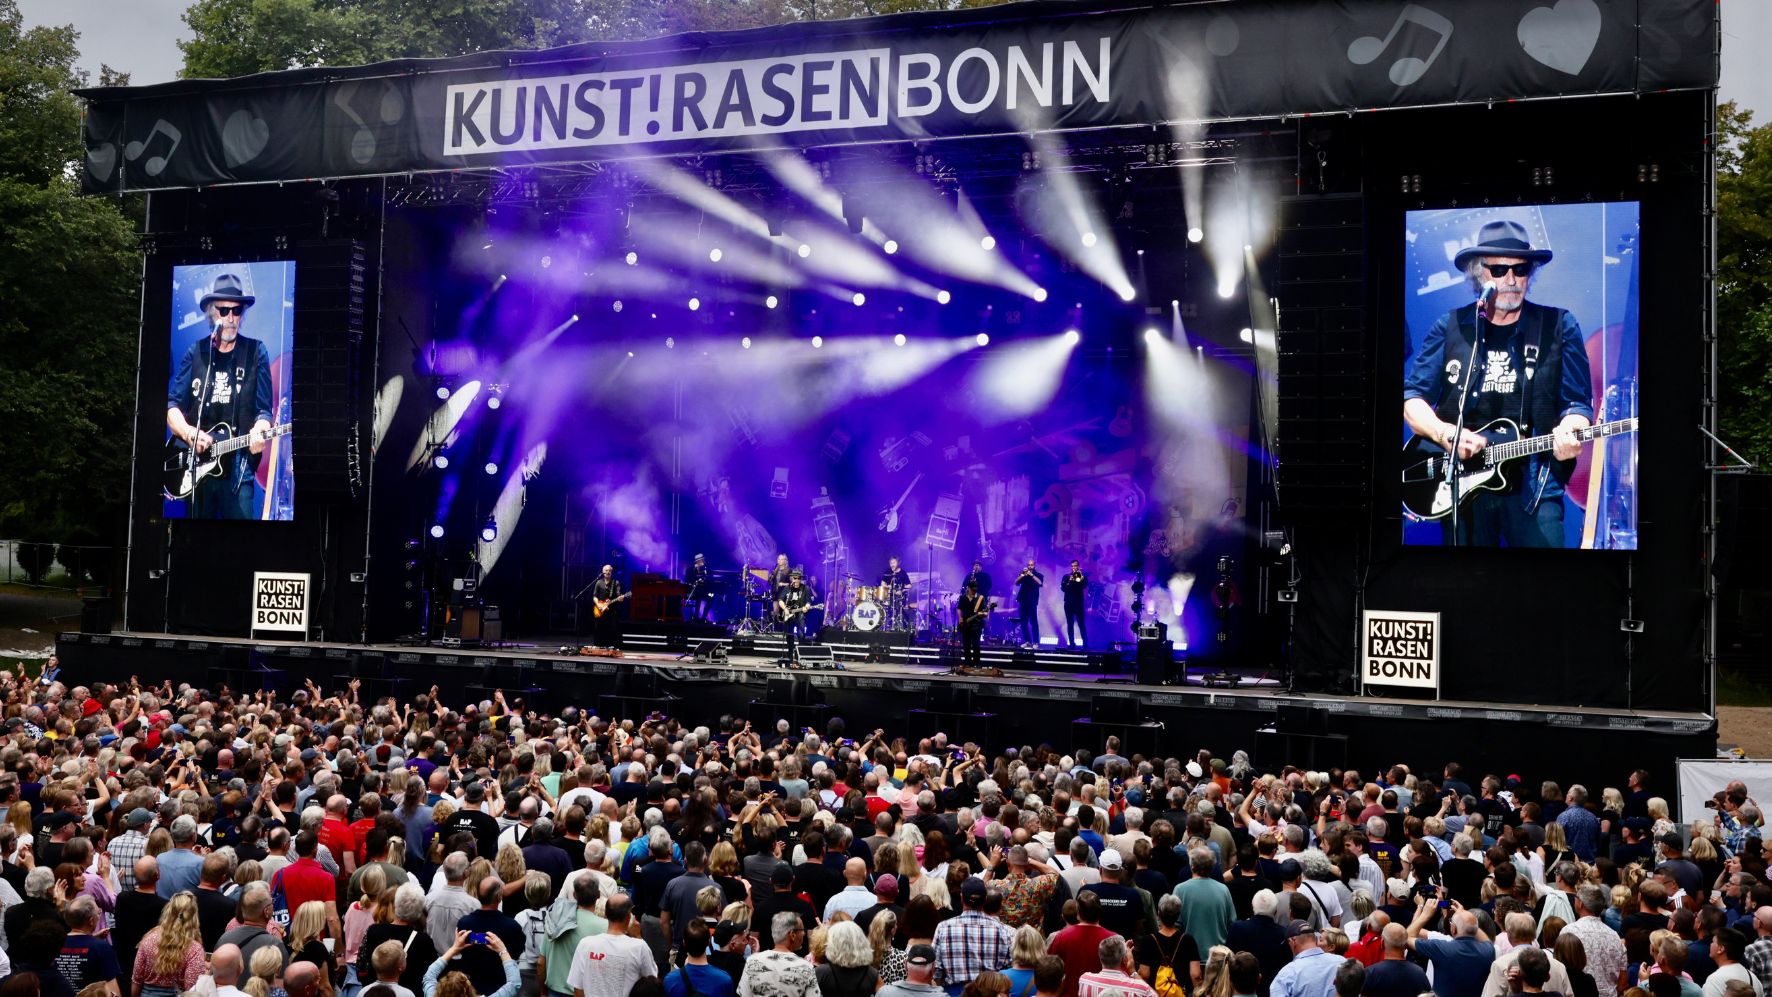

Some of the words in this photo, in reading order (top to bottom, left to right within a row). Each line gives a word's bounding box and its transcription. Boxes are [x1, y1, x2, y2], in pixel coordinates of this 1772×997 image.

[897, 36, 1111, 117] BONN
[1487, 350, 1508, 362] BAP
[258, 580, 304, 594] KUNST!
[260, 594, 301, 608] RASEN
[258, 610, 302, 625] BONN
[858, 610, 876, 618] BAP
[1370, 620, 1432, 640] KUNST!
[1373, 639, 1428, 658] RASEN
[1370, 660, 1430, 680] BONN
[590, 952, 605, 960] BAP
